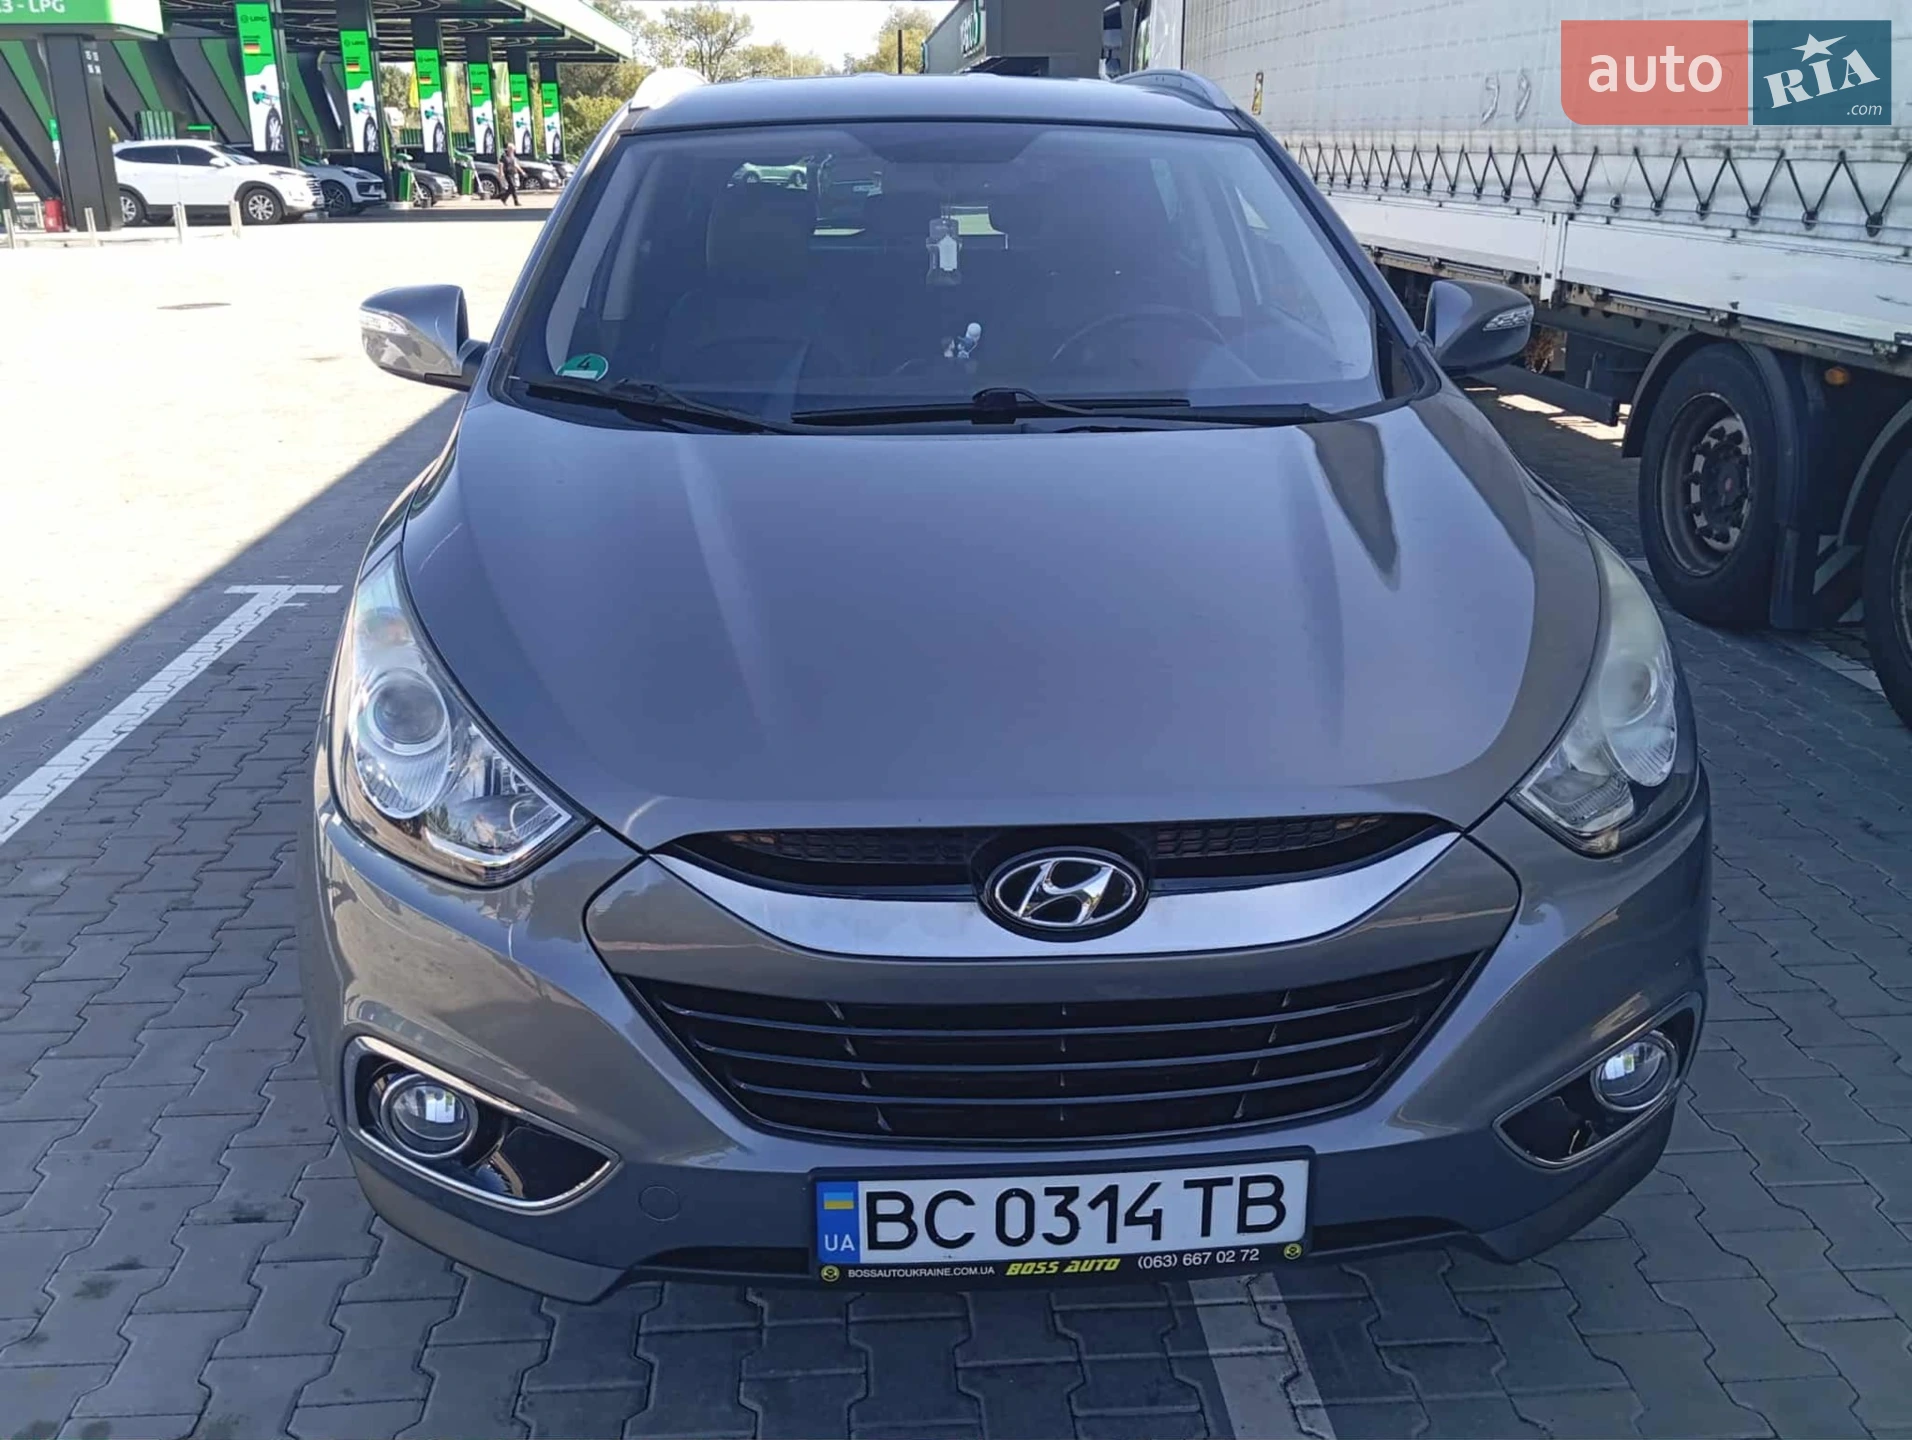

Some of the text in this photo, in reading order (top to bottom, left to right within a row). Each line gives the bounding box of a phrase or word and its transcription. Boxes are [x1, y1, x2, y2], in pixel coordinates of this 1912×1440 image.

[0, 0, 13, 13] 3
[28, 0, 65, 13] LPG
[577, 356, 592, 370] 4
[825, 1173, 1287, 1252] UA BC 0314 TB
[848, 1266, 996, 1279] BOSSAUTOUKRAINE.COM.UA
[1006, 1261, 1059, 1276] BOSS
[1138, 1254, 1178, 1270] (063)
[1183, 1252, 1212, 1266] 667
[1216, 1250, 1236, 1264] 02
[1240, 1248, 1260, 1262] 72
